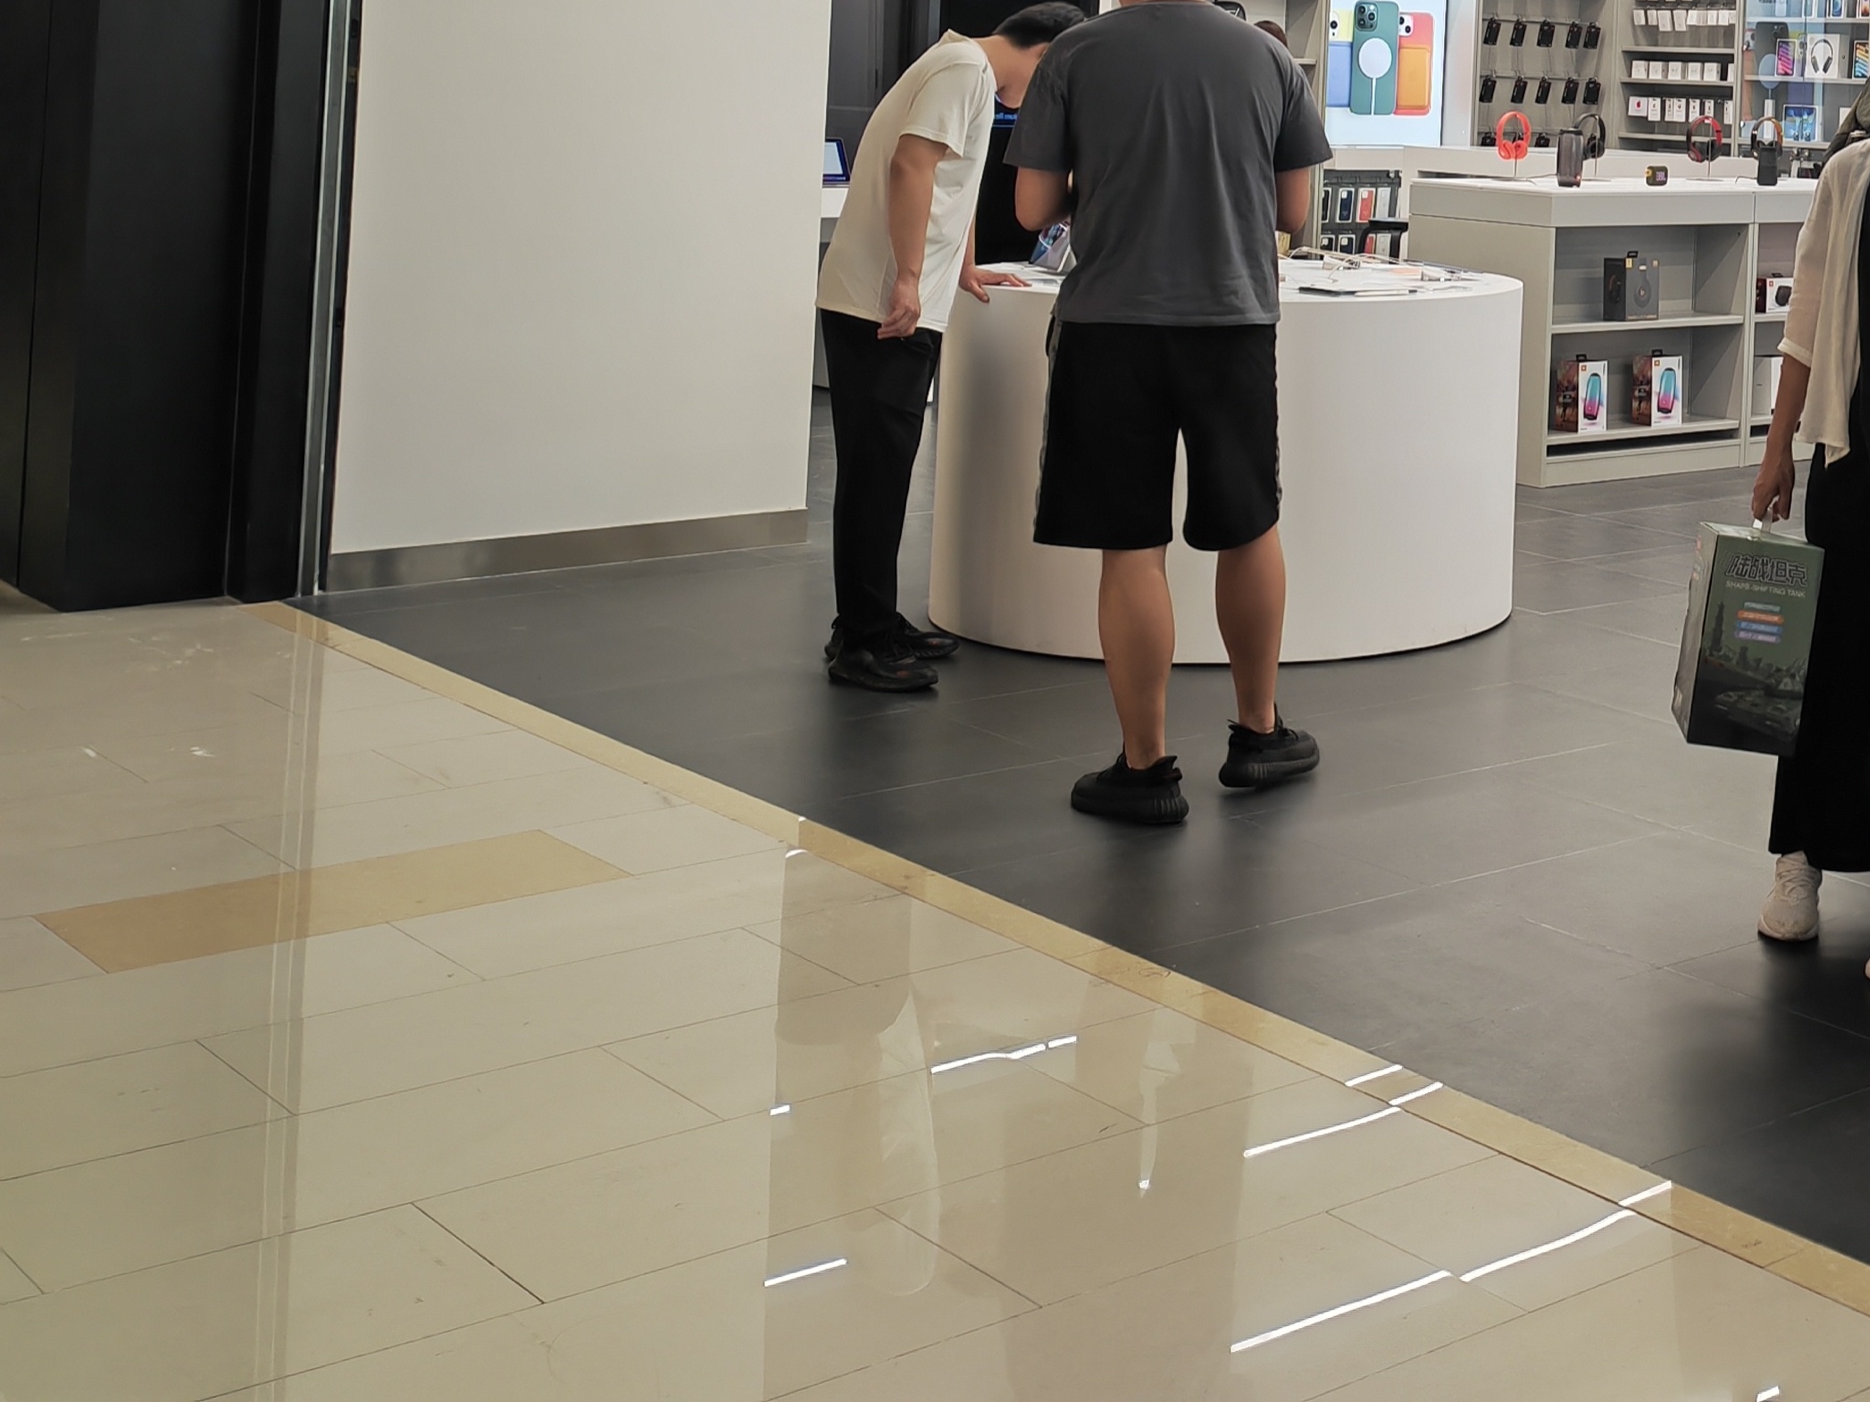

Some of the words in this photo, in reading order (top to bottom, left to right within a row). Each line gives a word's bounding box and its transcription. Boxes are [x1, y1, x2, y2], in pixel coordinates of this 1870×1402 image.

[1726, 554, 1807, 587] 陆战坦克
[1787, 589, 1806, 598] TANK
